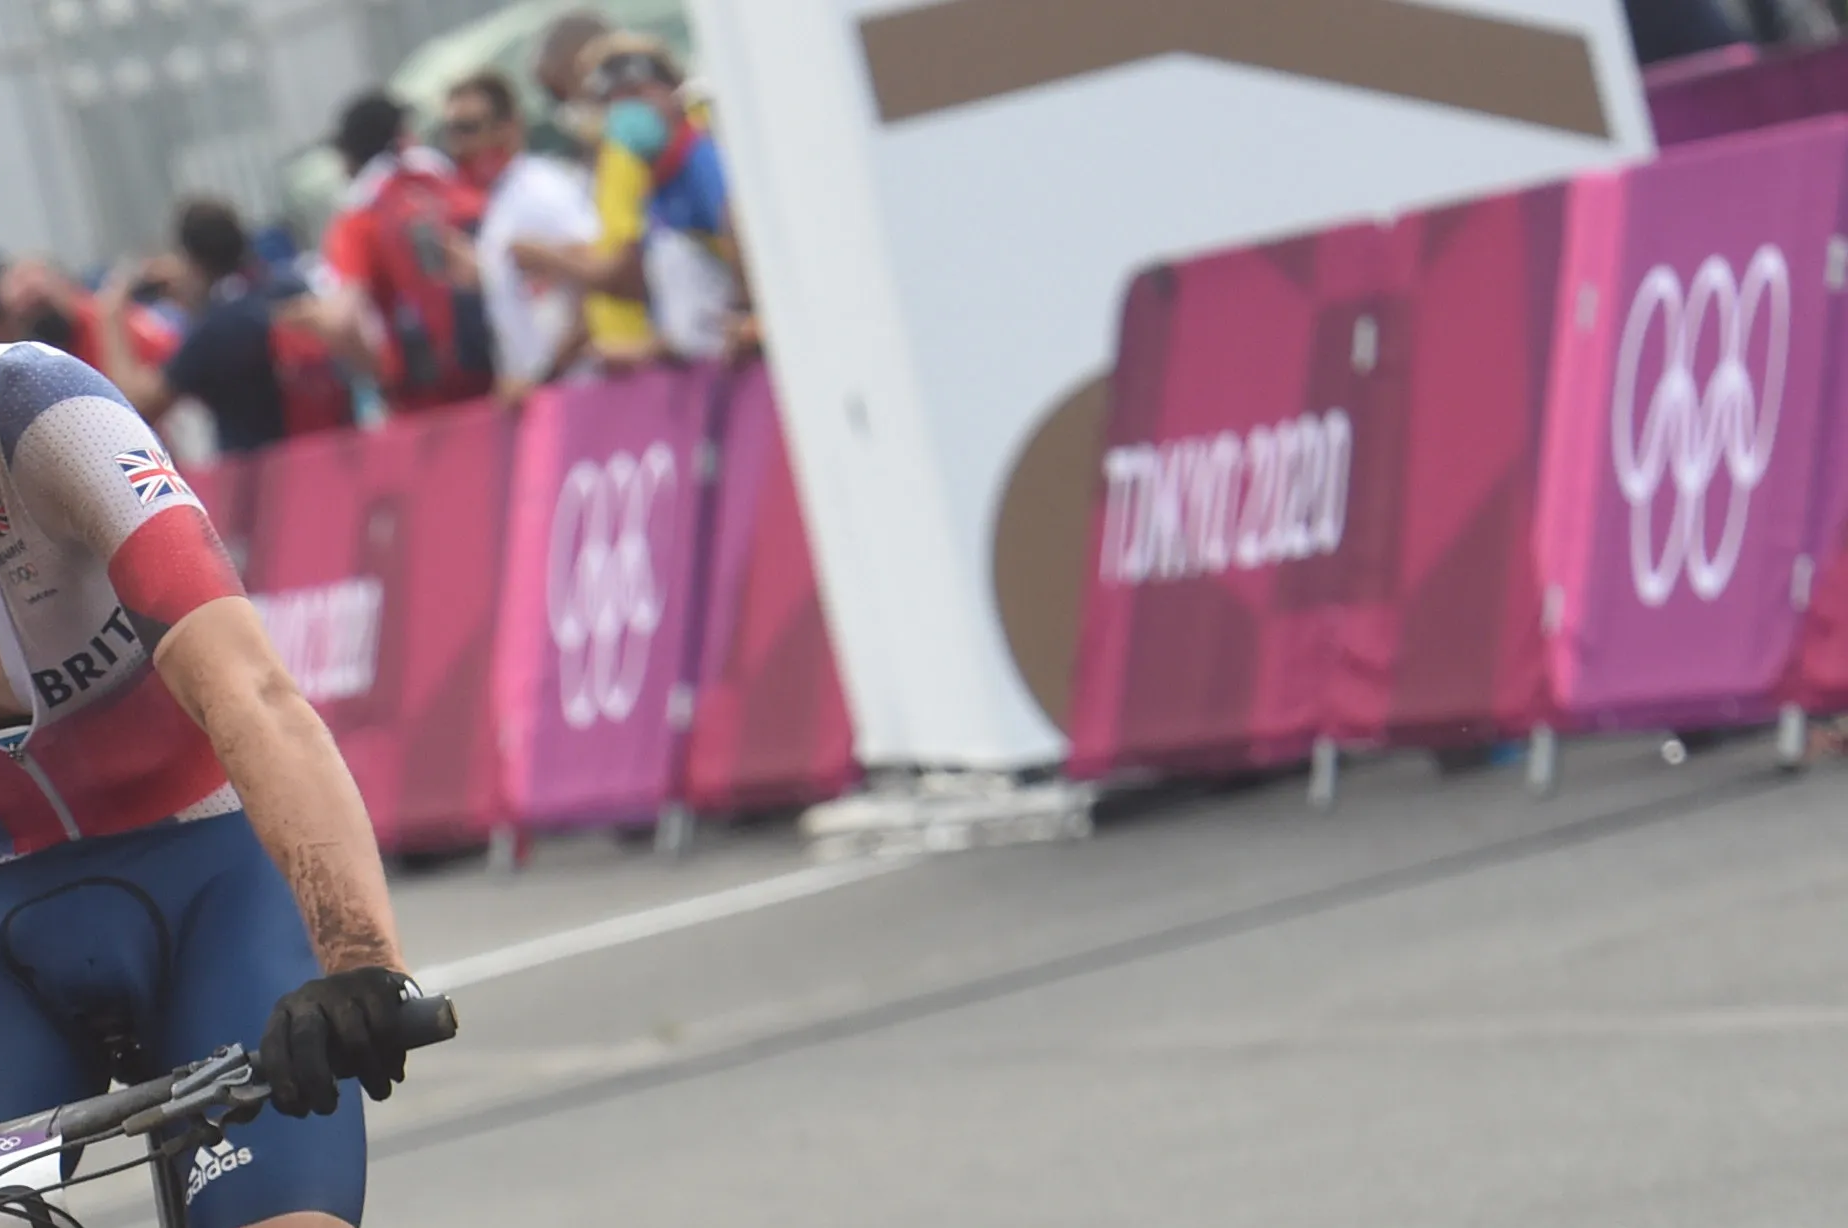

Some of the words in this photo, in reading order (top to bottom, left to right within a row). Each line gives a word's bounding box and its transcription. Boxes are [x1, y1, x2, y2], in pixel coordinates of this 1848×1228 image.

[1100, 430, 1243, 582] TOKYO
[1235, 406, 1351, 571] 2020
[185, 1147, 253, 1206] adidas
